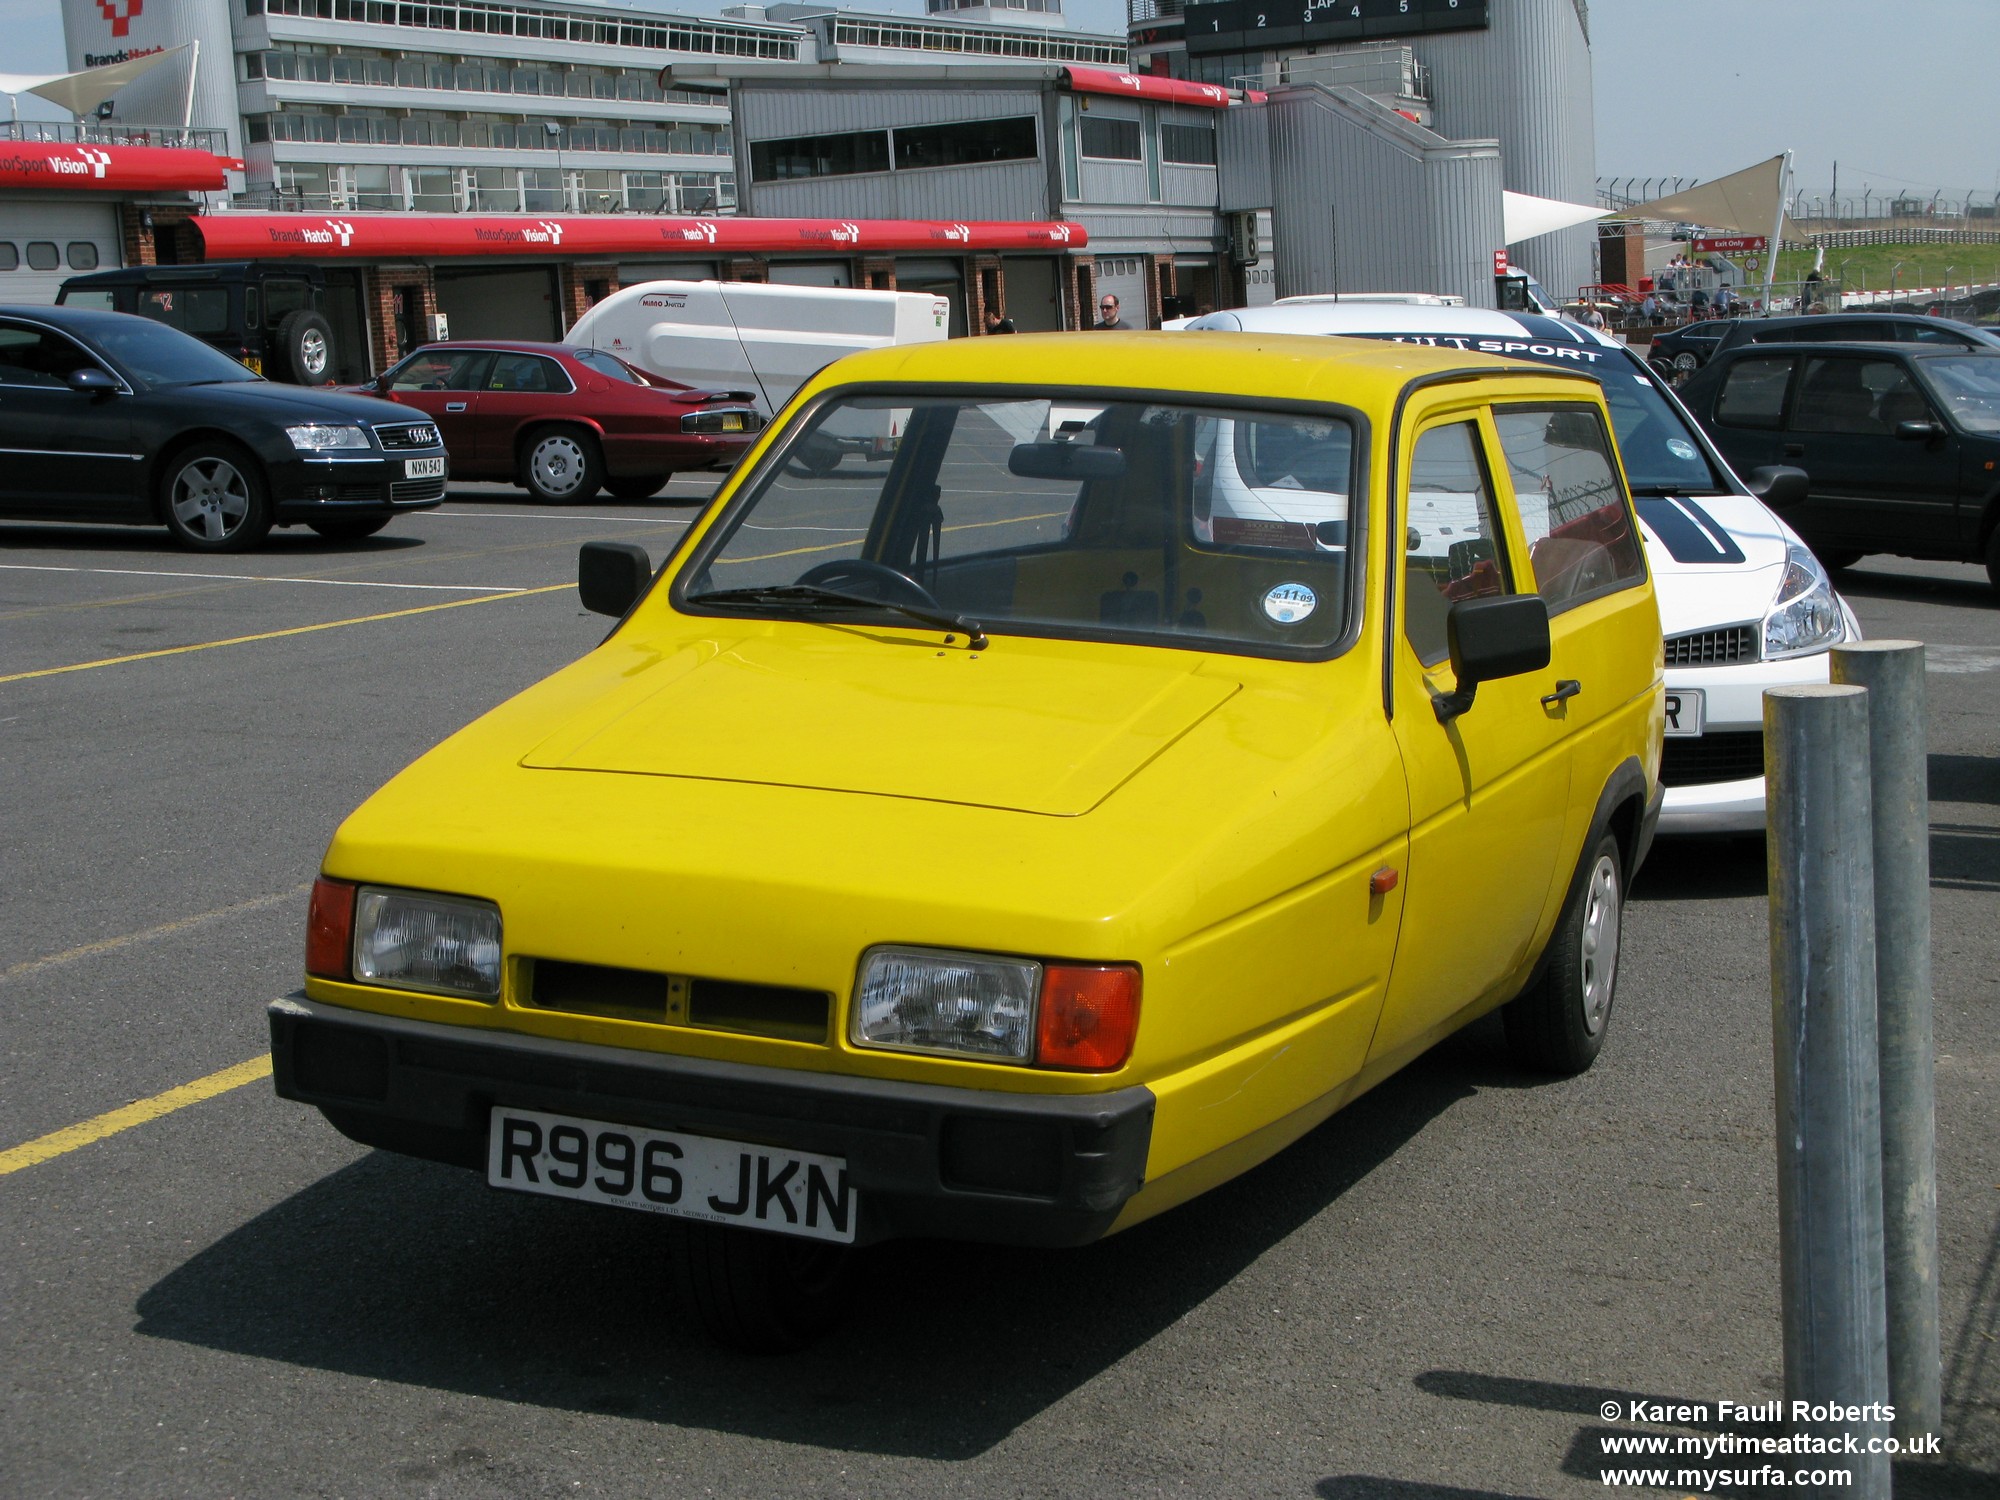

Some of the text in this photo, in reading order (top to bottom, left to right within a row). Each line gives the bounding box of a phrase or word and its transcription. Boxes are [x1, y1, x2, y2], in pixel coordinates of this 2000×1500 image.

[1308, 0, 1336, 10] LAP
[1212, 20, 1219, 32] 1
[1257, 15, 1266, 27] 2
[1304, 10, 1312, 22] 3
[1351, 5, 1360, 18] 4
[1400, 0, 1408, 12] 5
[0, 156, 89, 176] orSport Vision
[522, 229, 549, 242] Vision
[831, 229, 850, 240] Vision
[1728, 240, 1744, 248] Only
[1478, 341, 1602, 362] SPORT
[412, 459, 441, 475] NXN 543
[1283, 589, 1299, 600] 11
[1300, 594, 1313, 602] 09
[501, 1117, 848, 1233] R996 JKN
[640, 1202, 667, 1212] MOTORS
[682, 1210, 709, 1219] MEDWAY
